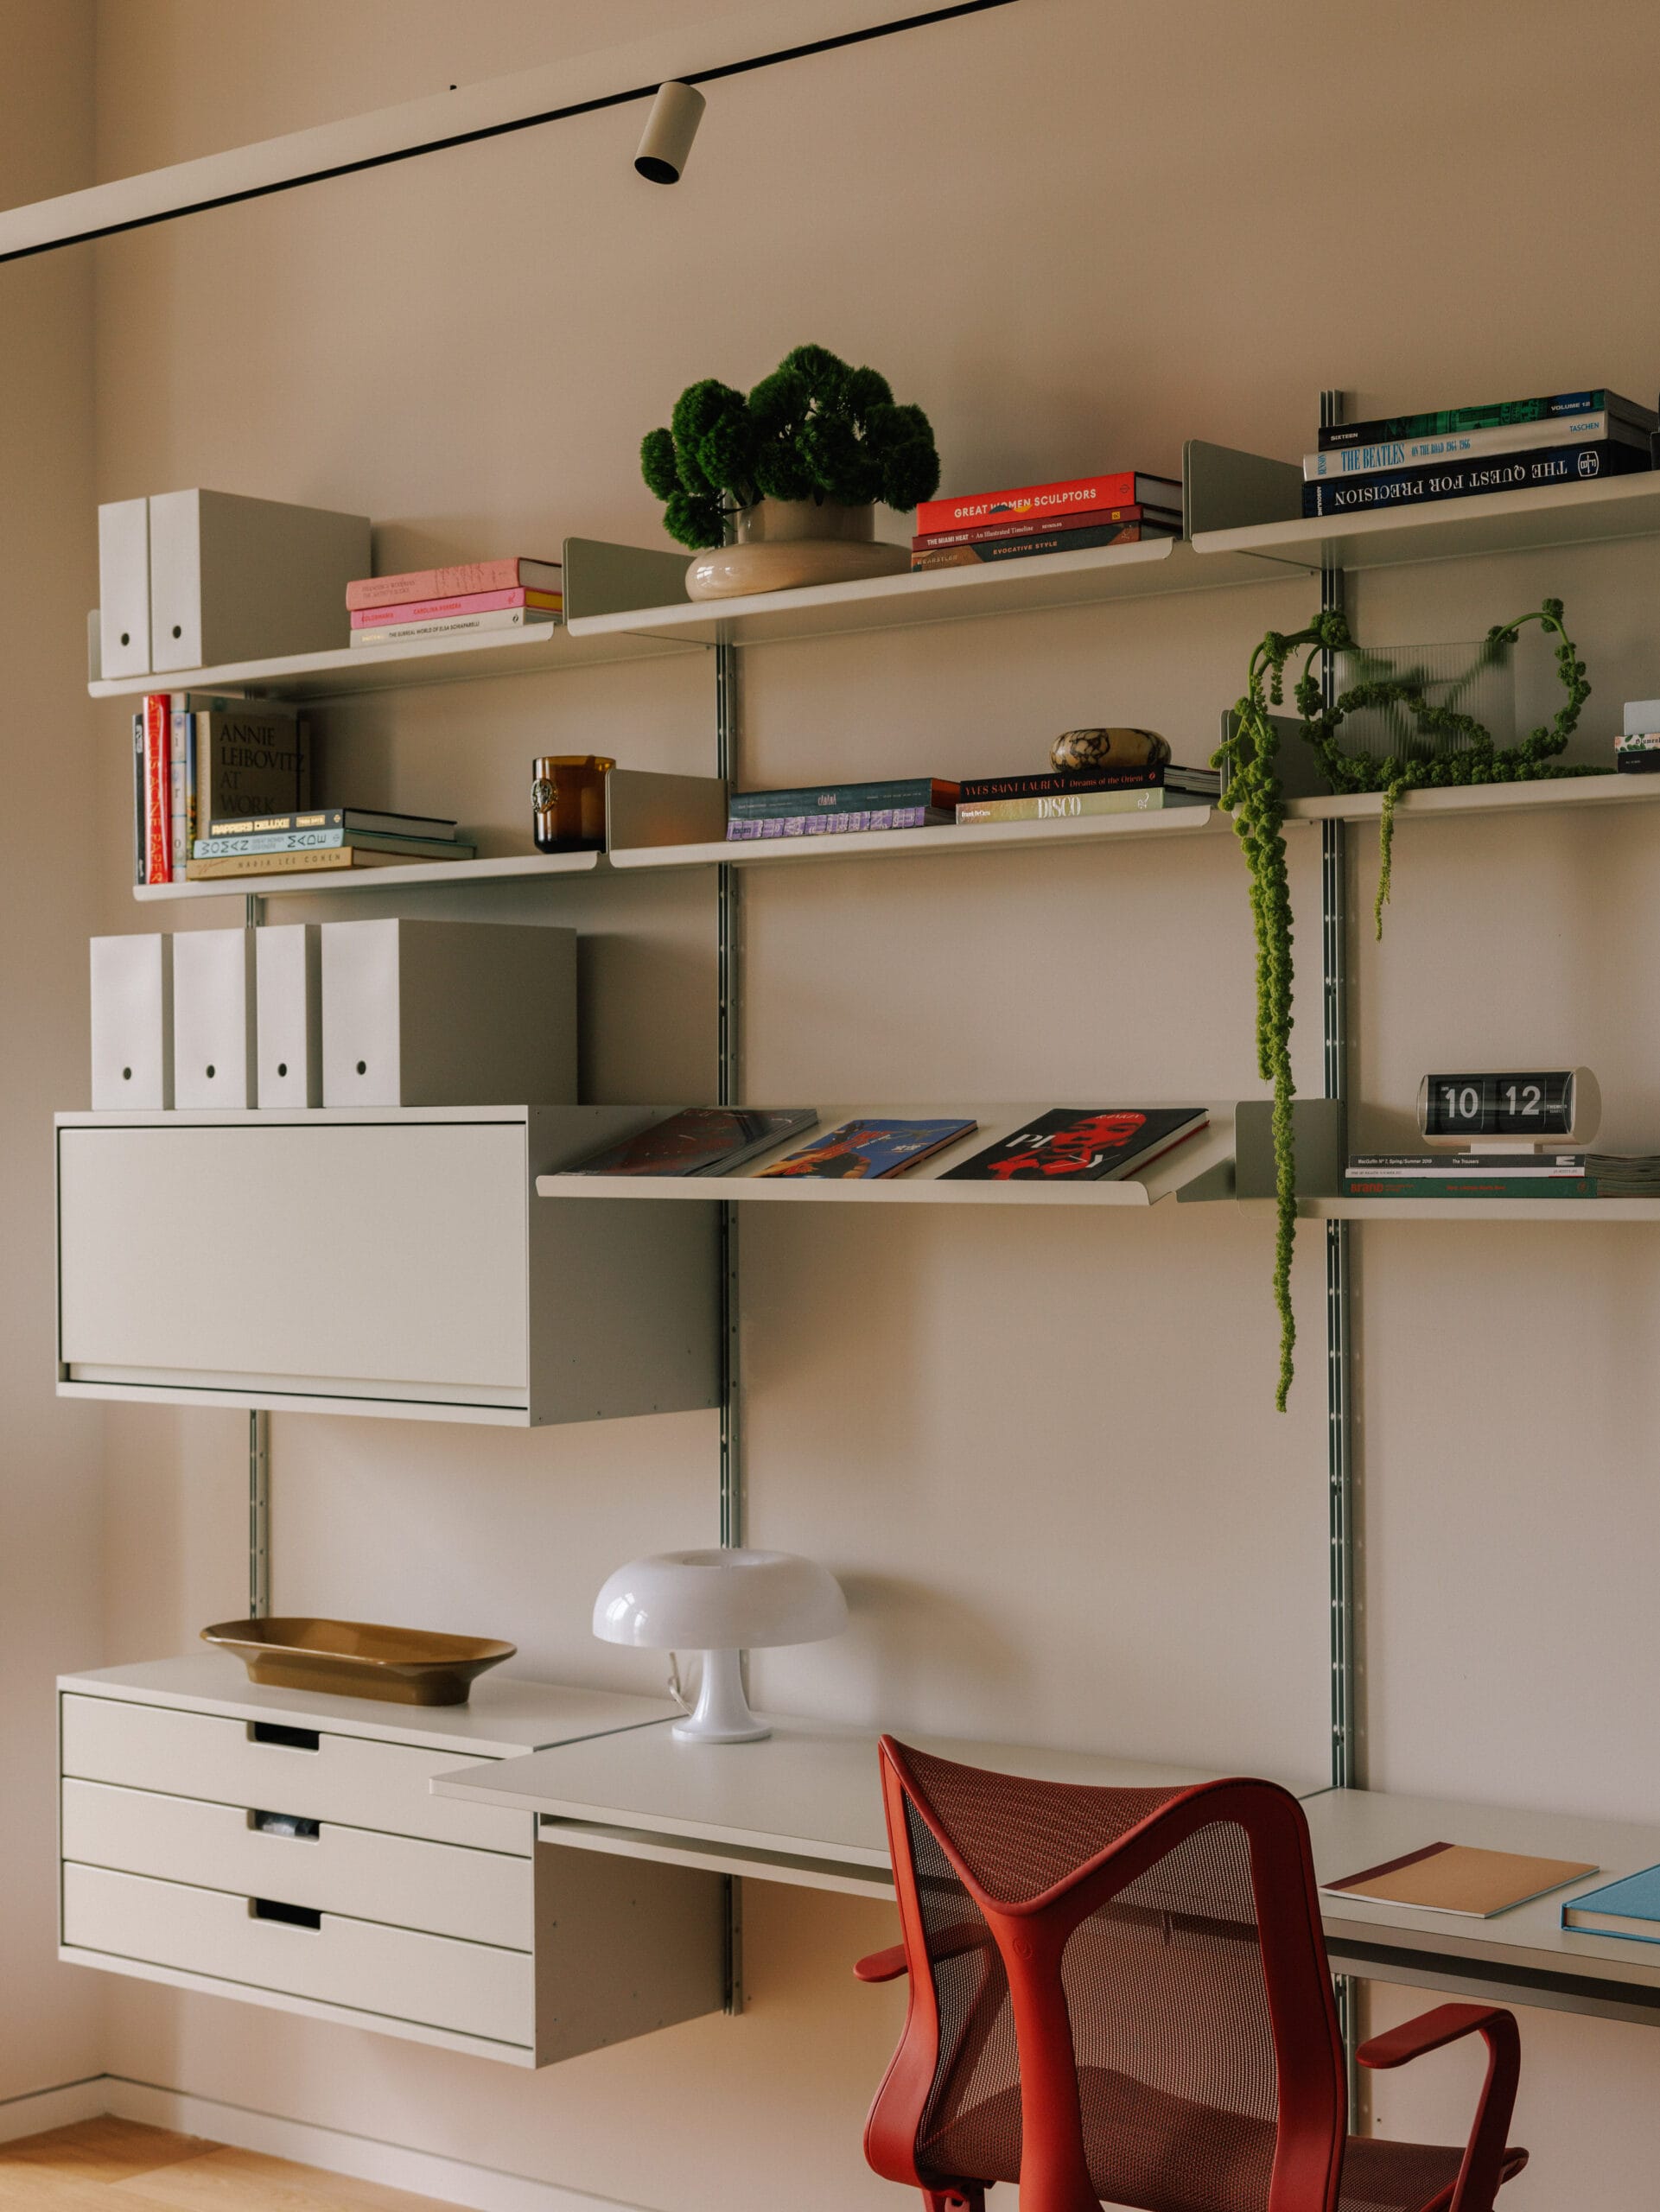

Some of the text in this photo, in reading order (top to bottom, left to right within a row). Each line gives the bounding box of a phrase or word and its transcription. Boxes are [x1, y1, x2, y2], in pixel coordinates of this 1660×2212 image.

[1550, 401, 1580, 412] VOLUME
[1330, 432, 1358, 442] SIXTEEN
[1569, 422, 1600, 433] TASCHEN
[1341, 448, 1361, 472] THE
[1363, 442, 1405, 469] BEATLES
[1334, 460, 1568, 505] THE QUEST FOR PRECISION
[954, 504, 988, 518] GREAT
[1034, 488, 1097, 507] SCULPTORS
[938, 536, 955, 544] MIAMI
[955, 533, 969, 542] HEAT
[983, 528, 1010, 538] Illustrated
[1011, 525, 1034, 534] Timeline
[993, 544, 1033, 555] EVOCATIVE
[413, 606, 438, 615] CAROLINA
[219, 723, 276, 747] ANNIE
[221, 747, 305, 772] LEIBOVITZ
[219, 770, 242, 790] AT
[964, 774, 1143, 796] YVES SAINT LAURENT Dreams of the Orient
[219, 792, 277, 815] WORK
[1037, 795, 1081, 818] DISCO
[201, 834, 327, 855] WOMAN MADE
[150, 834, 162, 882] PAPER
[1445, 1085, 1542, 1119] 10 12
